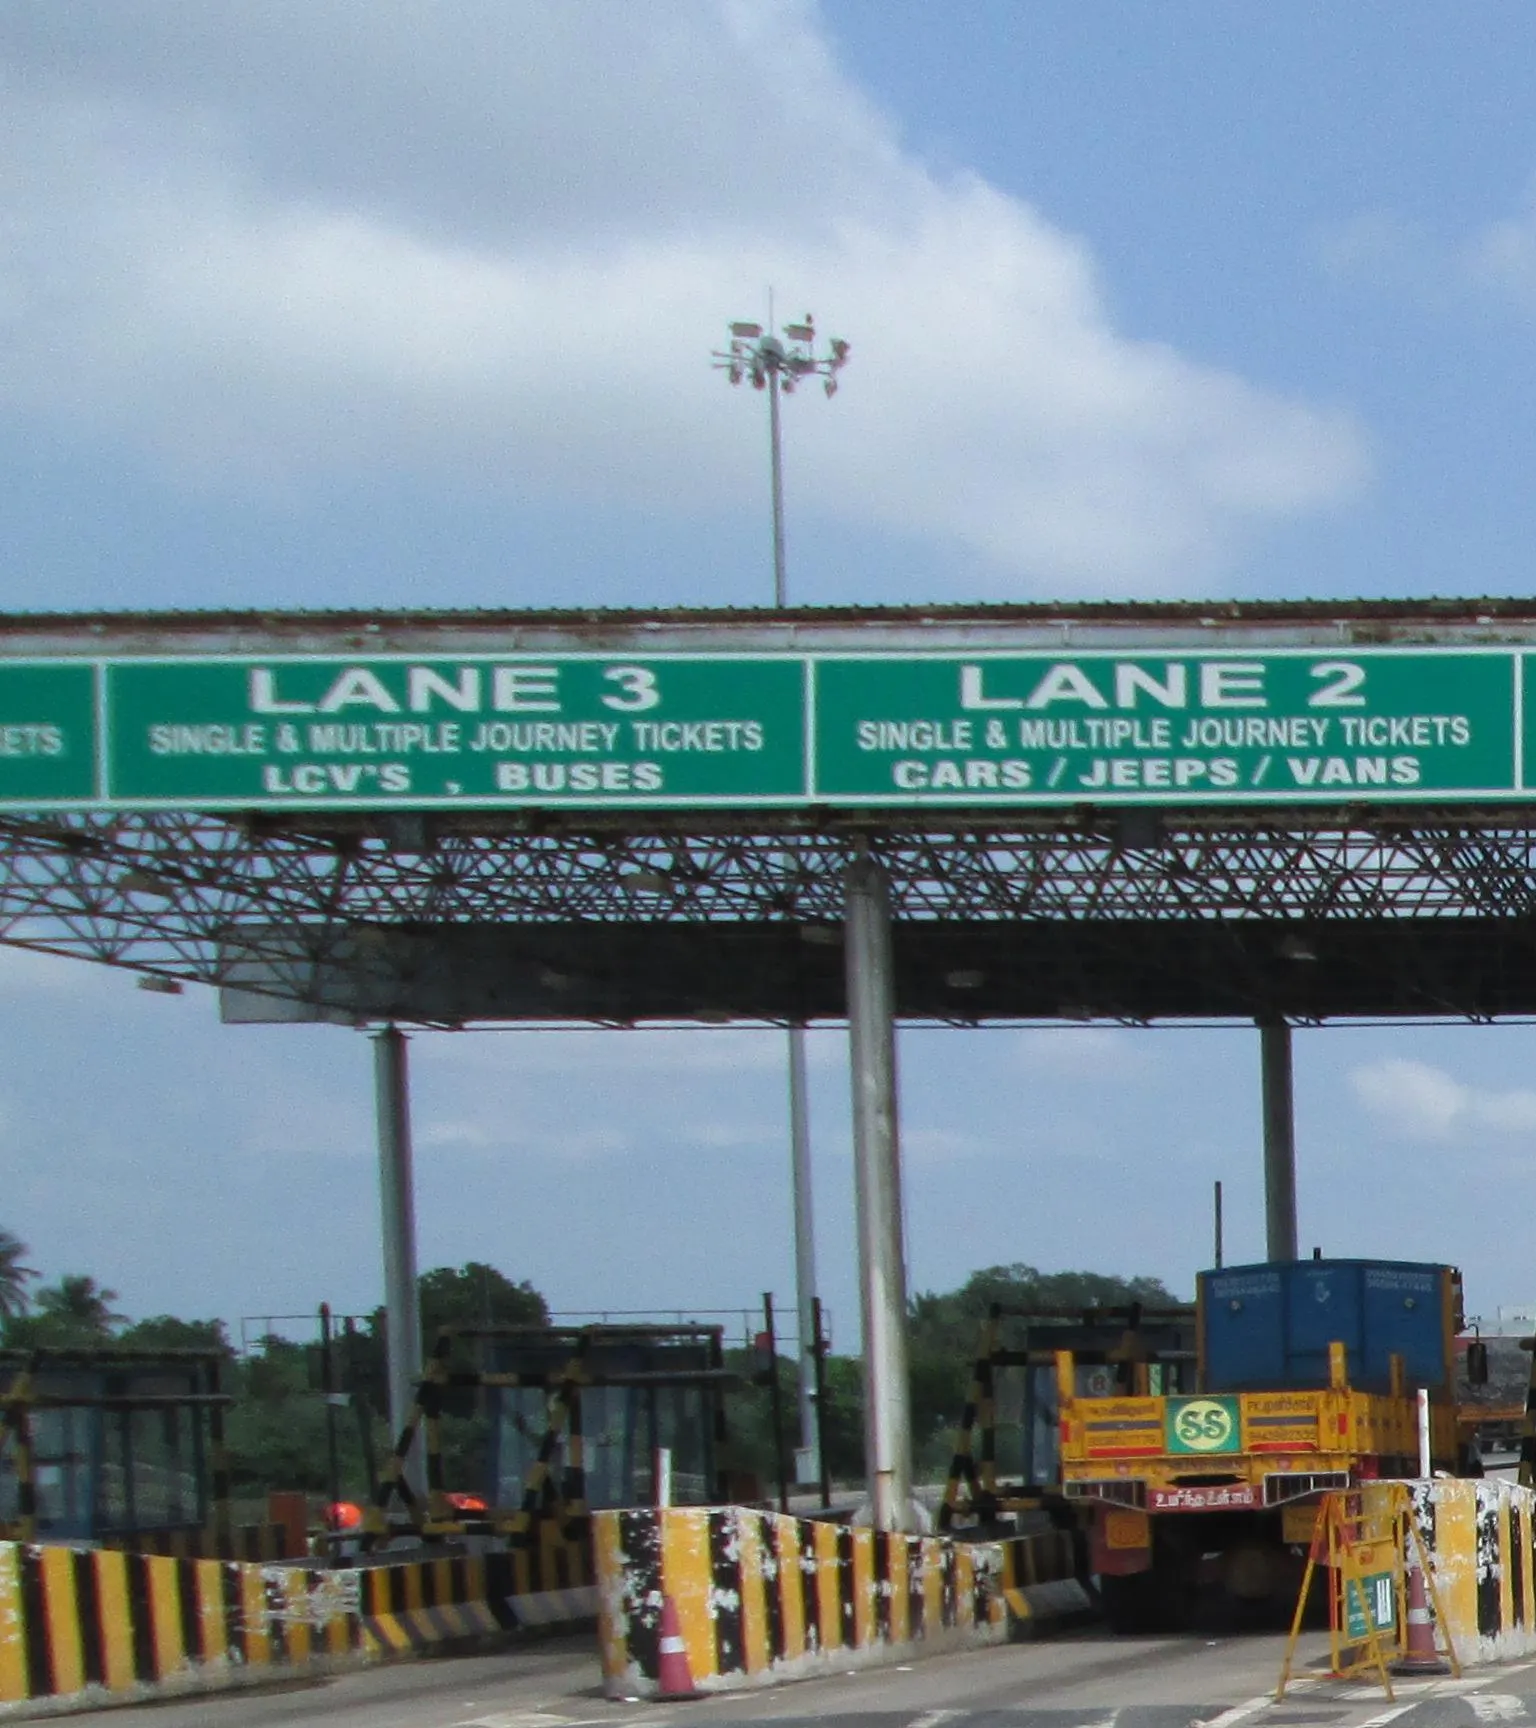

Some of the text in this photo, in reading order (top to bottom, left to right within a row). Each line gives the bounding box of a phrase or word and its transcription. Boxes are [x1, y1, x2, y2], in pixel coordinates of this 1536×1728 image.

[248, 665, 662, 714] LANE 3
[959, 661, 1368, 711] LANE 2
[150, 719, 764, 755] SINGLE & MULTIPLE JOURNEY TICKETS
[857, 715, 1470, 752] SINGLE & MULTIPLE JOURNEY TICKETS
[496, 761, 665, 793] BUSES
[891, 758, 1031, 790] CARS
[1078, 756, 1240, 788] JEEPS
[1286, 754, 1421, 786] VANS
[1179, 1409, 1226, 1441] SS
